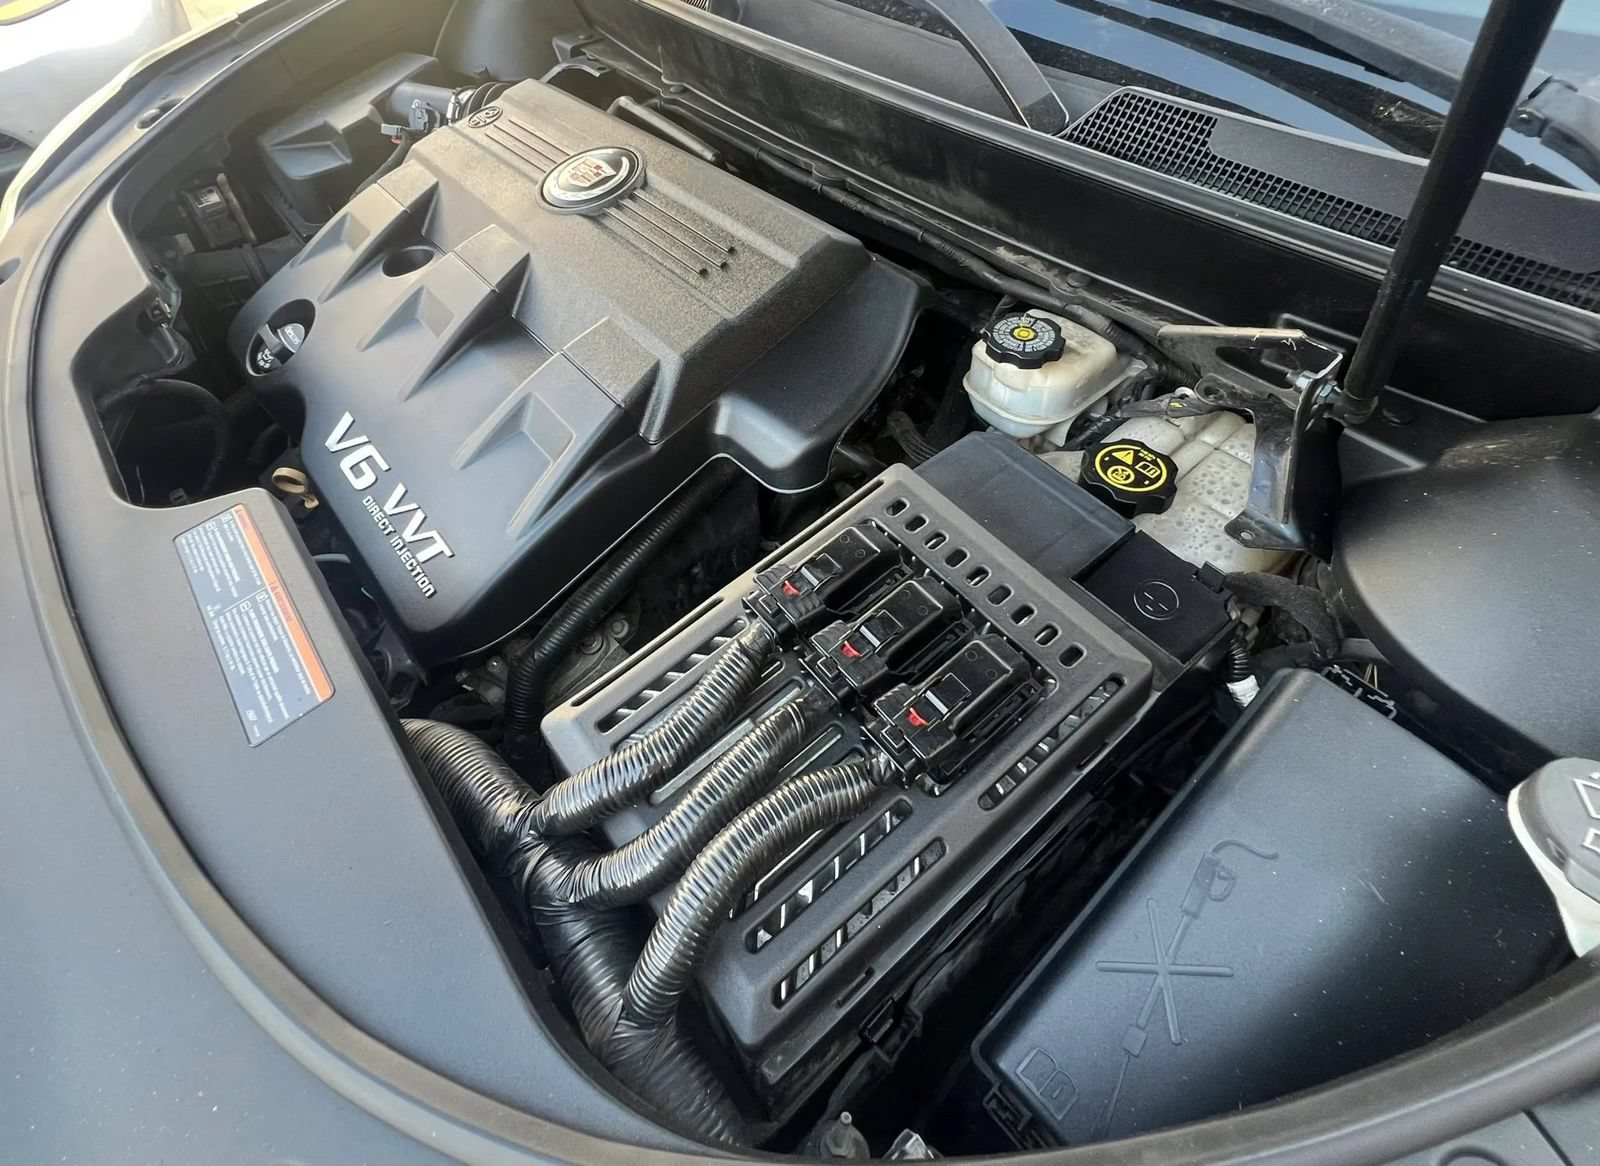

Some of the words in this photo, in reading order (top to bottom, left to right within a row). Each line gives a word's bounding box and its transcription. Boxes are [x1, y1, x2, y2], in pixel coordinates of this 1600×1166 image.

[325, 411, 391, 491] V6
[382, 482, 456, 564] VVT
[362, 495, 395, 537] DIRECT
[389, 536, 437, 599] INJECTION
